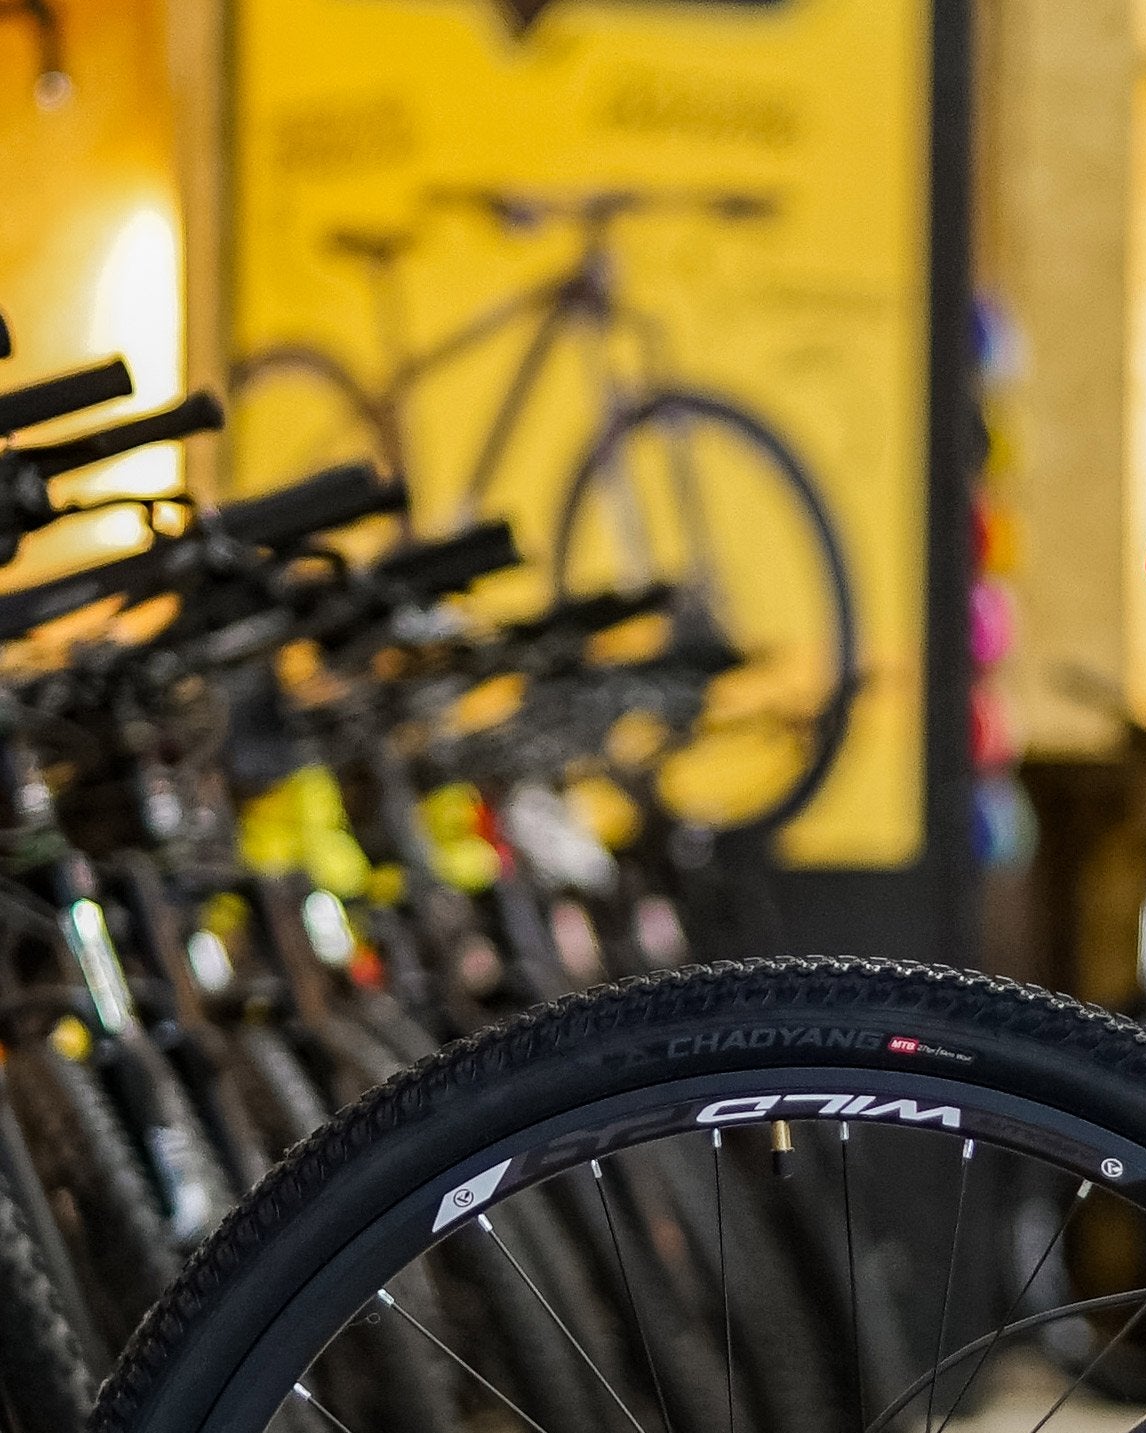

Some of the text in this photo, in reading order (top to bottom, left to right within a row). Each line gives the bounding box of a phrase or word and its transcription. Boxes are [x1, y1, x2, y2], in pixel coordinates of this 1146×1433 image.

[667, 1027, 916, 1059] CHAOYANG MTB
[696, 1094, 961, 1128] WILD
